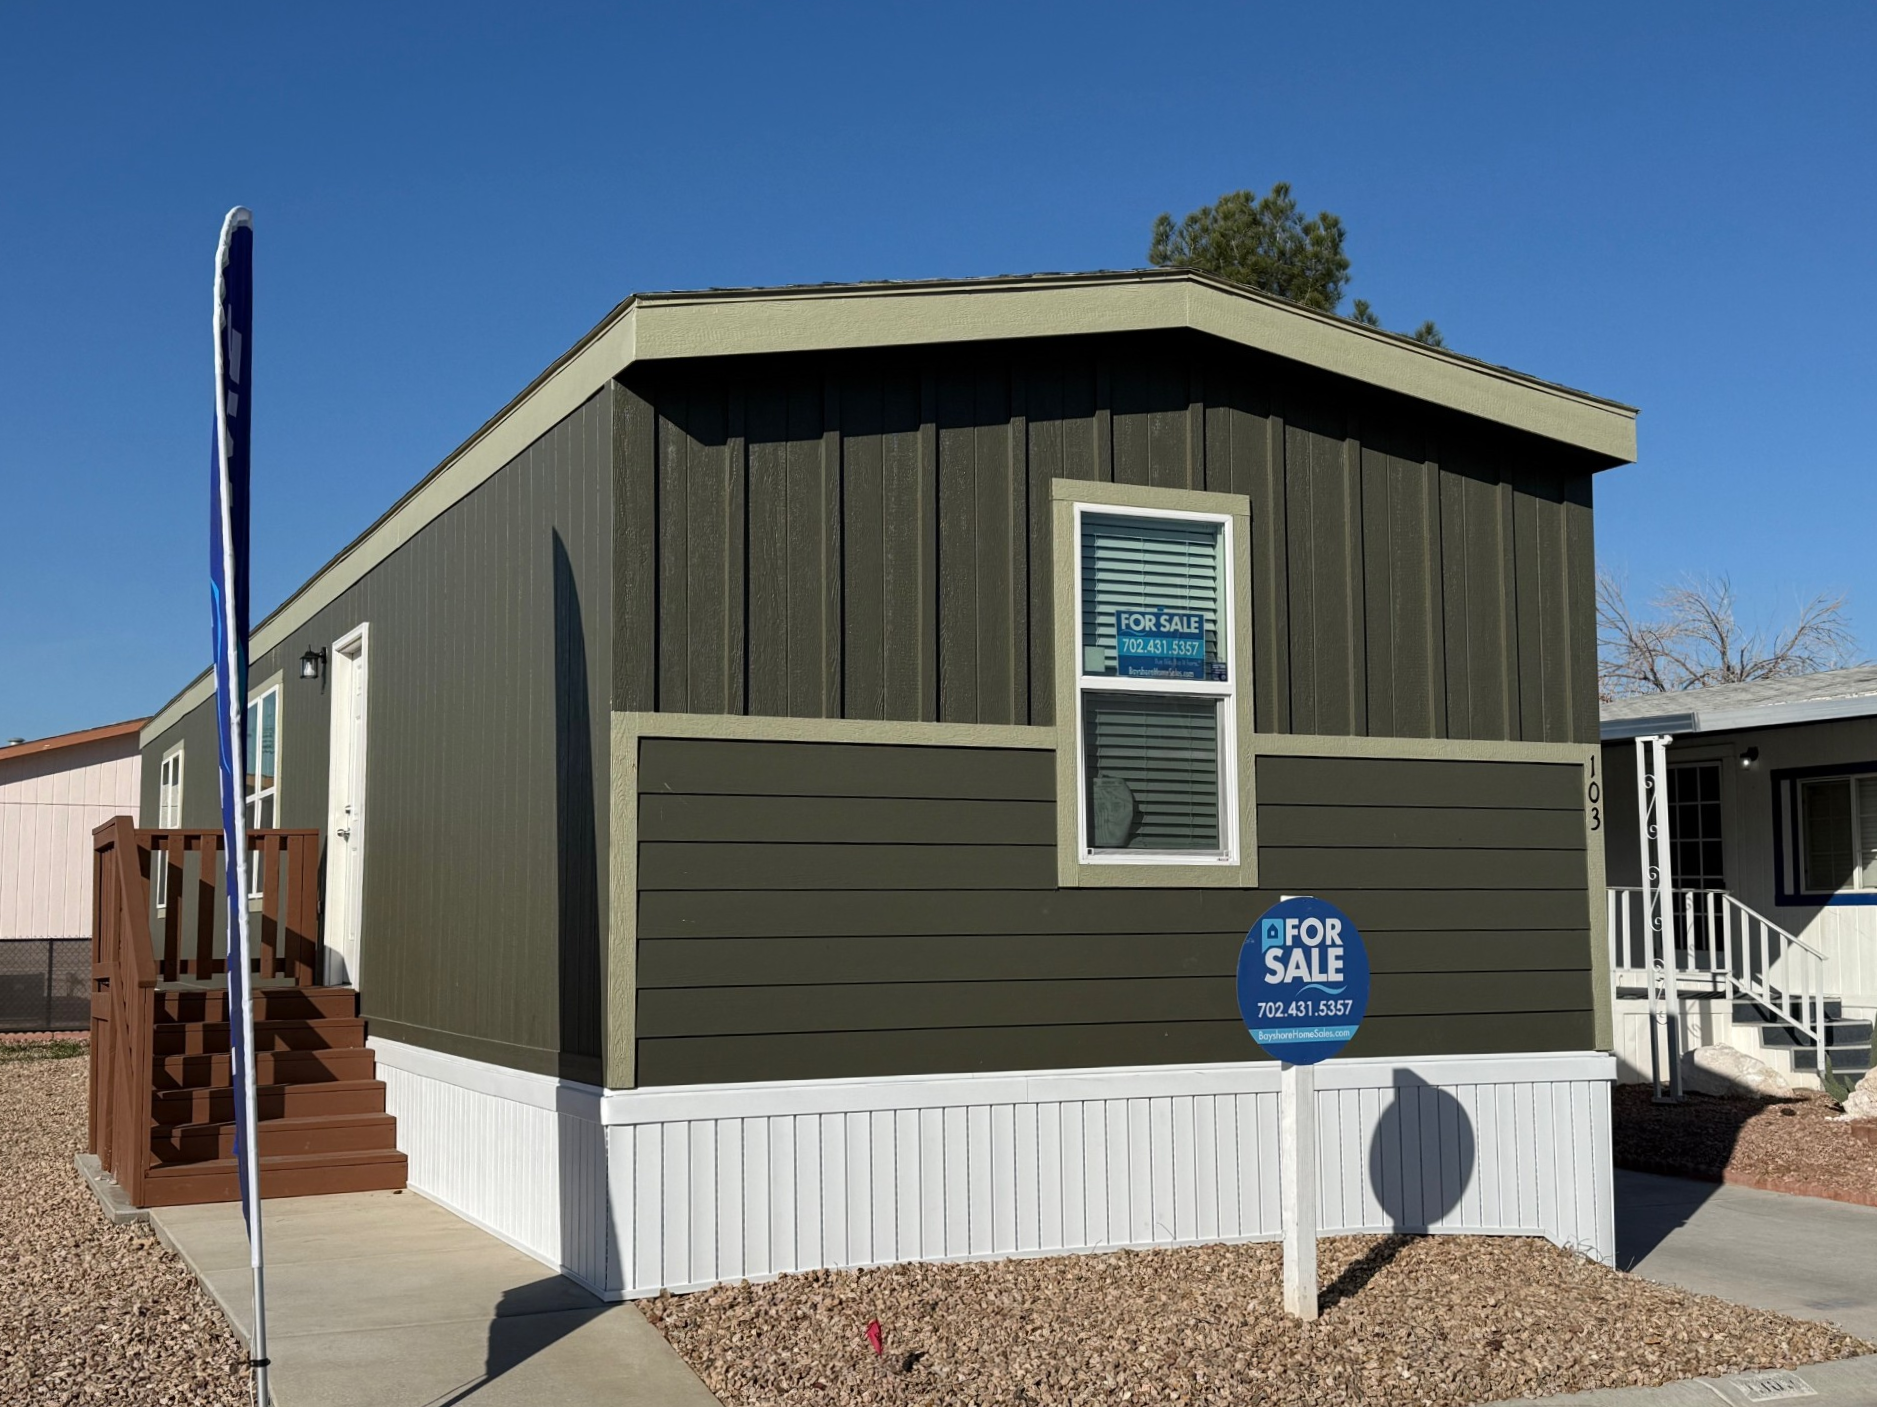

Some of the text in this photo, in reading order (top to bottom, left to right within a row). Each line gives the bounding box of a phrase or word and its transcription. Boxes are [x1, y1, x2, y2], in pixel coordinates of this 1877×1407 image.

[1120, 613, 1200, 633] FOR SALE
[1122, 638, 1199, 656] 702.431.5357
[1588, 755, 1601, 831] 103
[1285, 917, 1343, 946] FOR
[1264, 947, 1344, 984] SALE
[1257, 1000, 1353, 1018] 702.431.5357
[1258, 1029, 1350, 1043] BayshoreHomeSales.com
